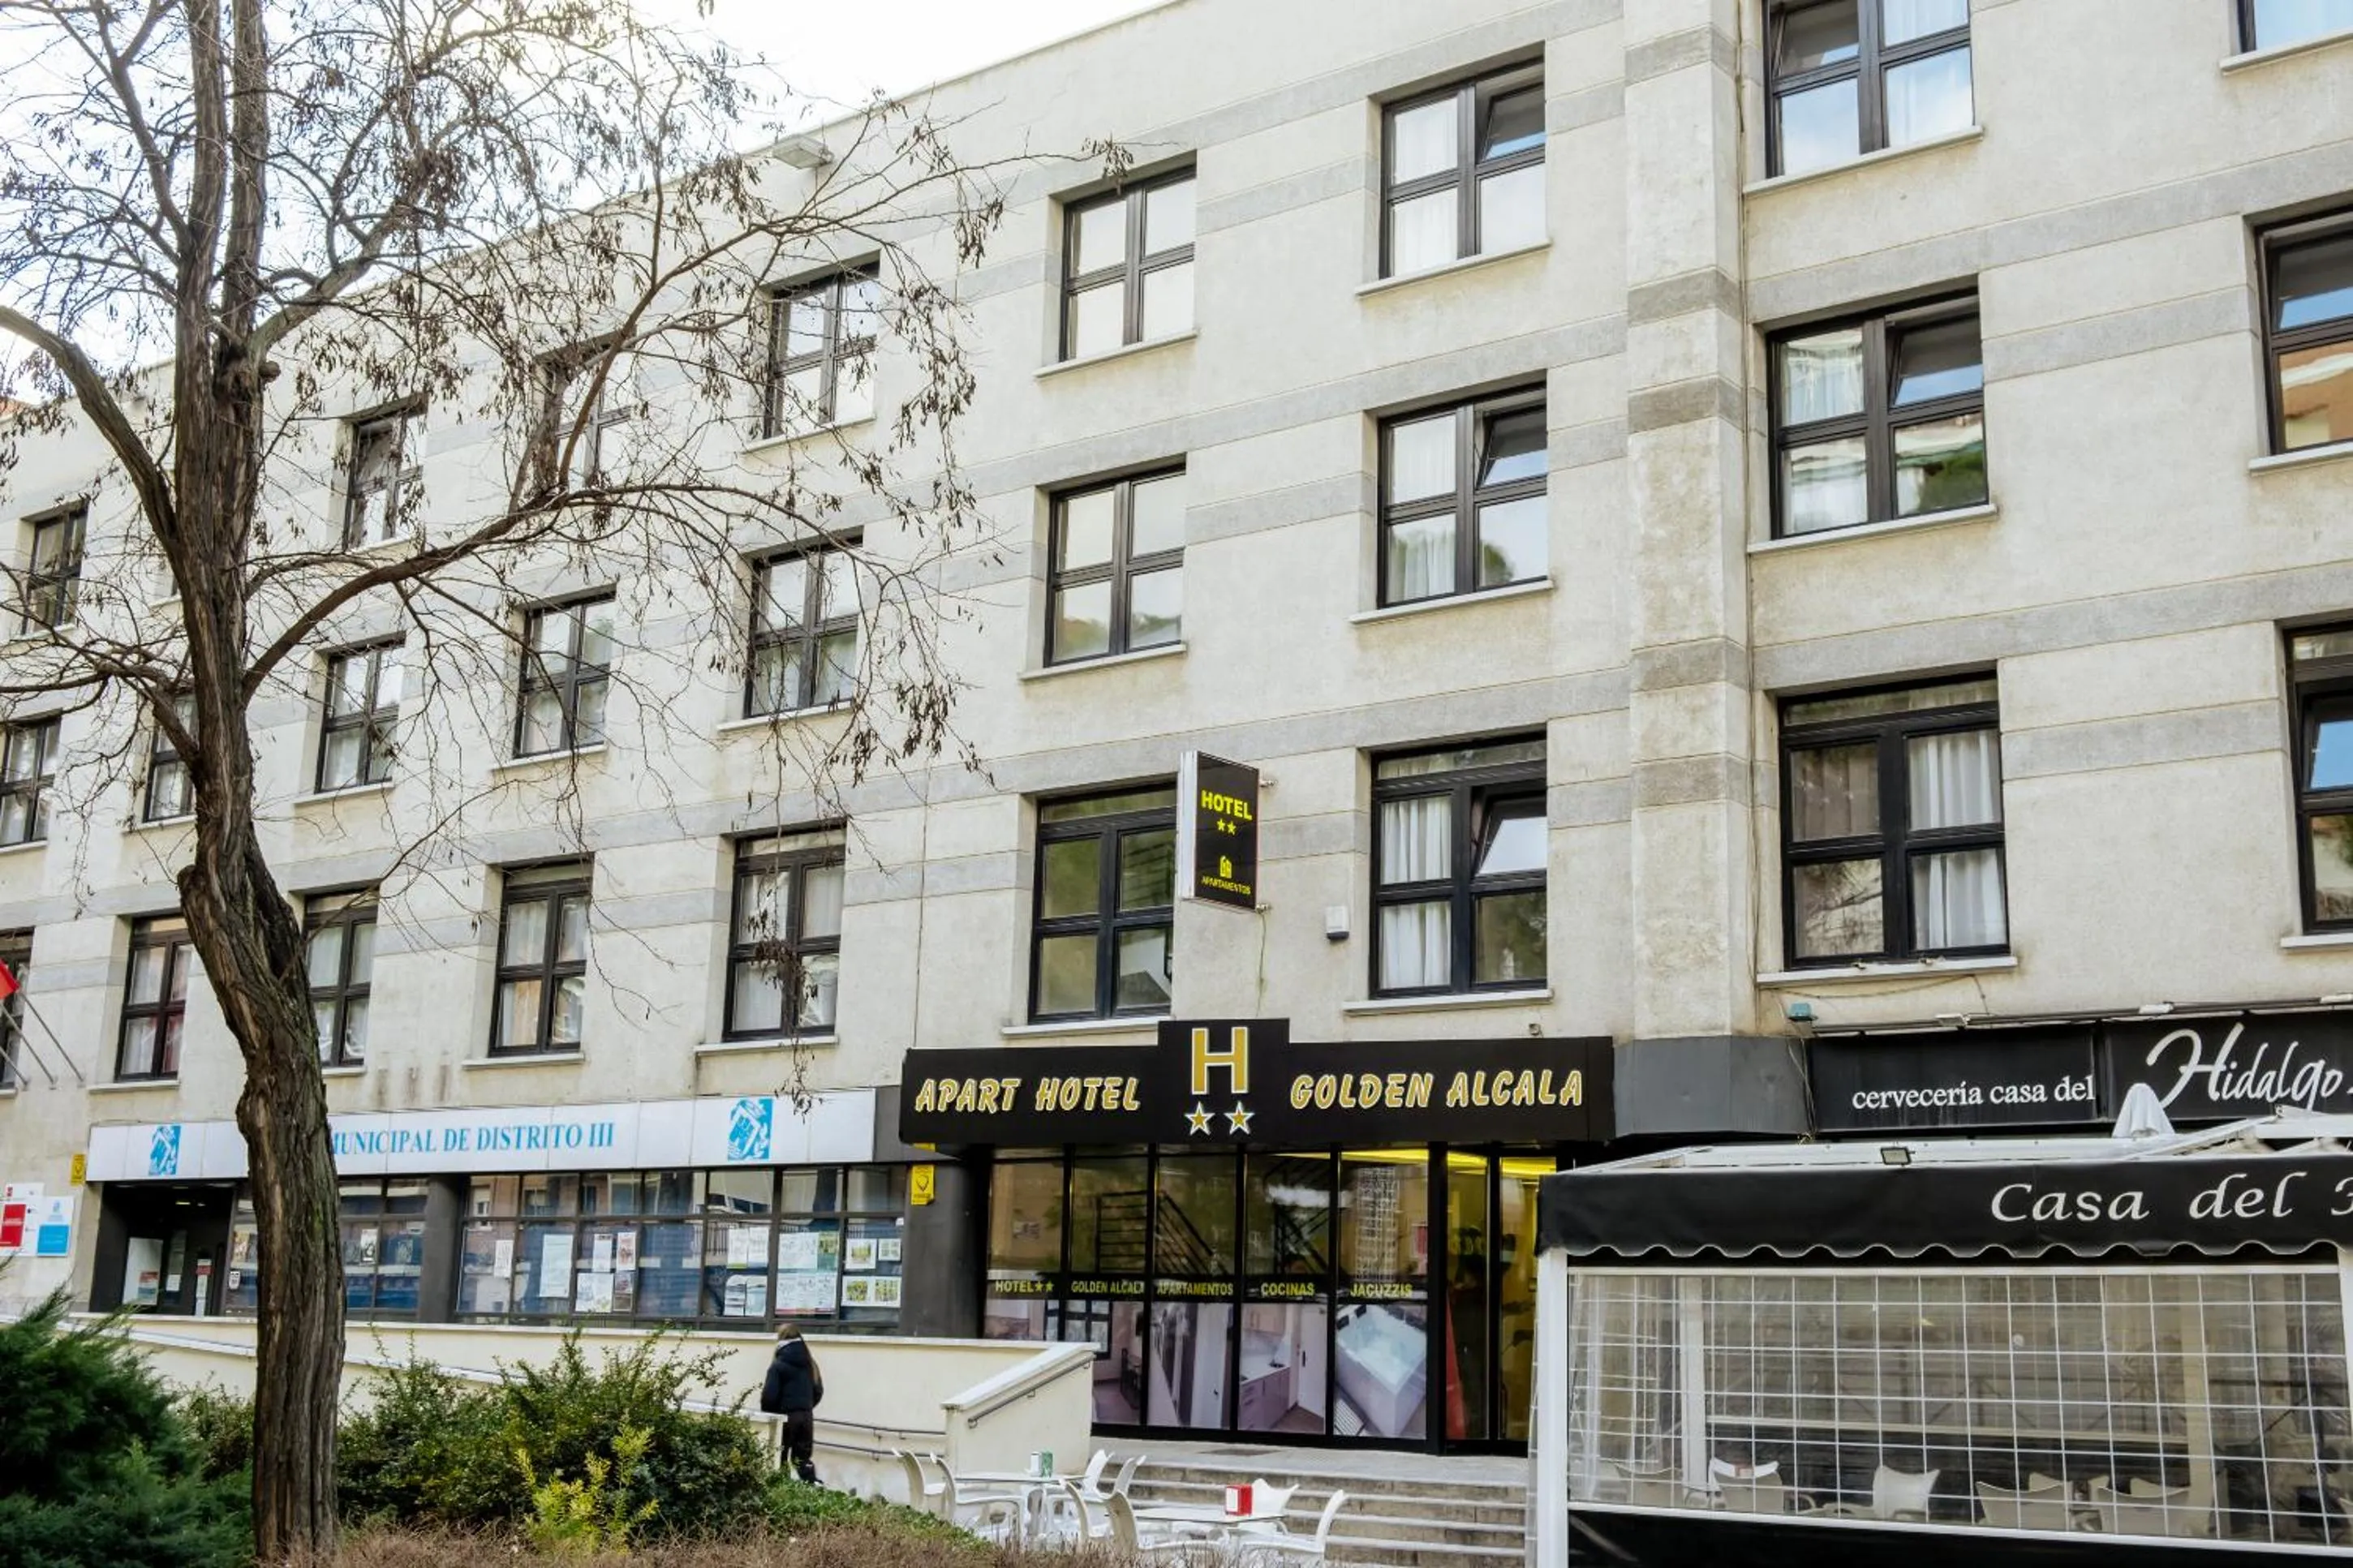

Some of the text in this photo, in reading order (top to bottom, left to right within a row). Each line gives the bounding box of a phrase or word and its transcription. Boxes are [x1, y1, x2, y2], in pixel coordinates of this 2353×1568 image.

[1201, 790, 1253, 820] HOTEL
[1192, 1026, 1249, 1095] H
[2145, 1022, 2343, 1111] Hidalgo
[914, 1076, 1141, 1114] APART HOTEL
[1290, 1069, 1583, 1109] GOLDEN ALCALA
[1852, 1074, 2097, 1109] cervecería casa del
[443, 1128, 471, 1152] DE
[477, 1123, 583, 1151] DISTRITO
[589, 1122, 615, 1148] III
[1990, 1183, 2150, 1222] Casa
[2189, 1171, 2307, 1219] del
[996, 1280, 1034, 1293] HOTEL
[1071, 1281, 1108, 1293] GOLDEN
[1157, 1282, 1234, 1295] APARTAMENTOS
[1261, 1282, 1315, 1296] COCINAS
[1350, 1282, 1413, 1298] JACUZZIS
